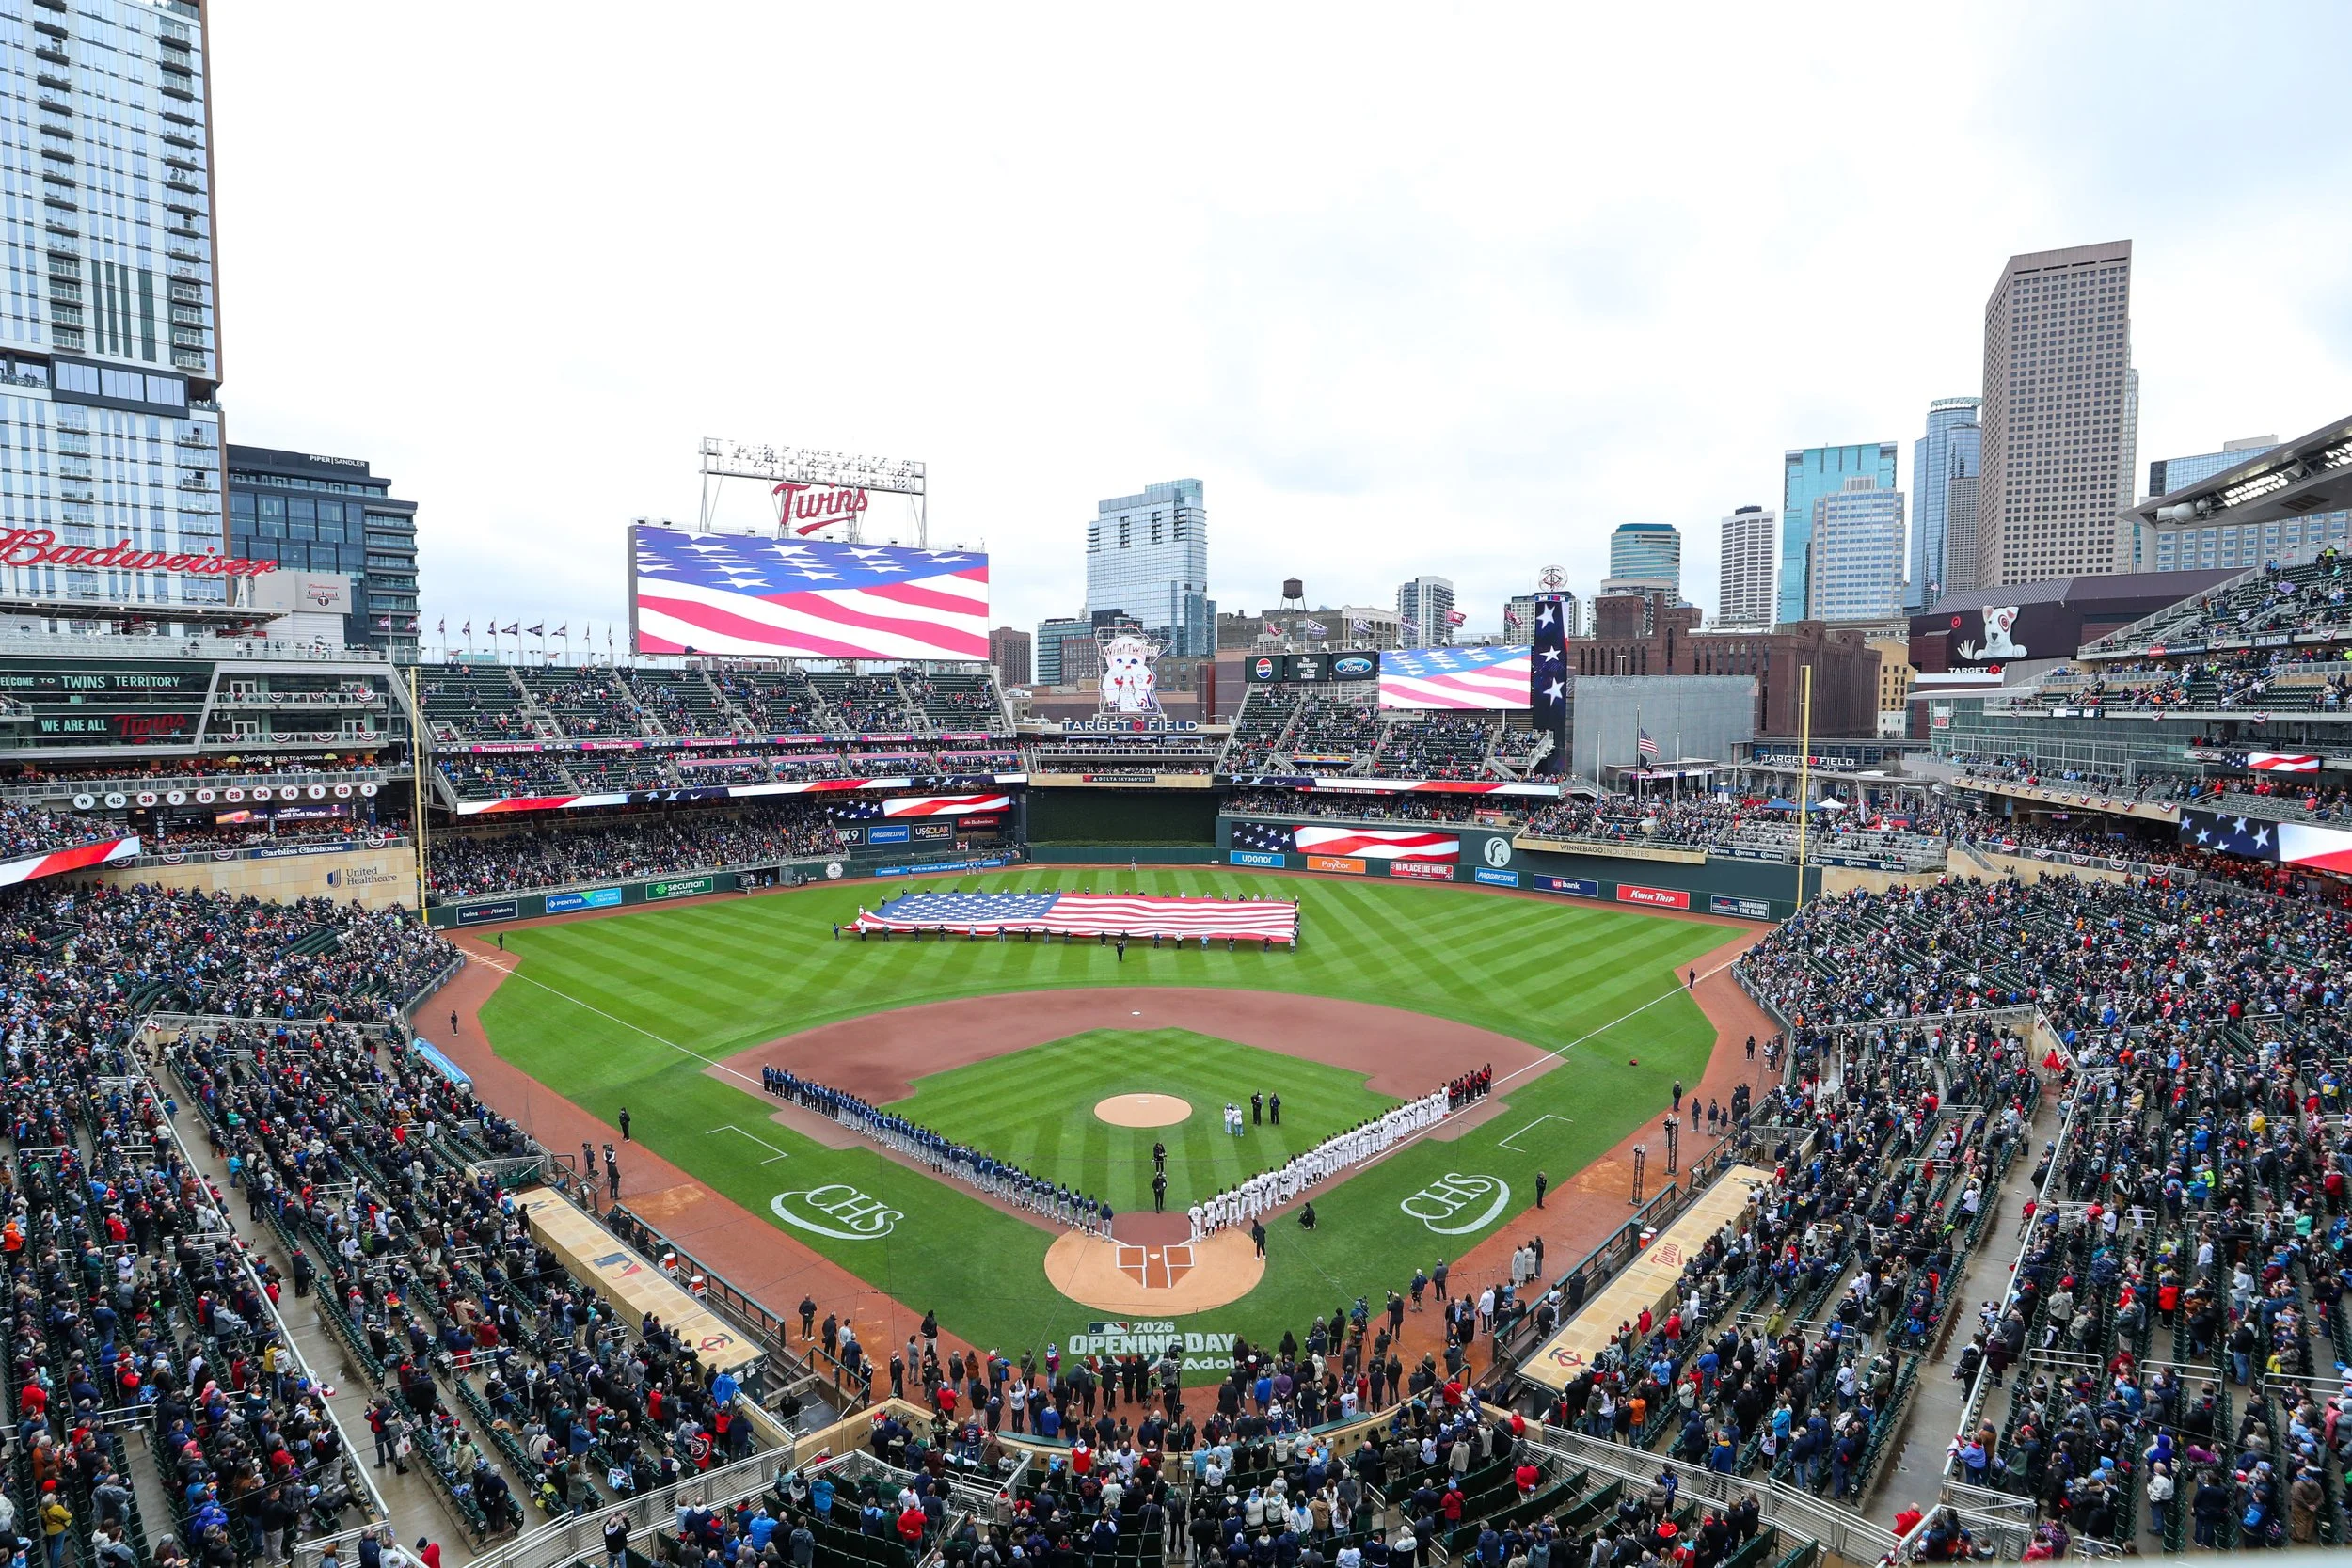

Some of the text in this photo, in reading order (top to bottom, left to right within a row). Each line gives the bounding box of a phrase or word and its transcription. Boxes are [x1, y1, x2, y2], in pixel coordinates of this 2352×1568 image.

[334, 457, 365, 467] SANDLER
[773, 483, 868, 531] Twins
[0, 528, 278, 576] Budweiser
[2255, 635, 2288, 647] END RACISM
[1342, 661, 1365, 672] Ford
[0, 677, 34, 687] ELCOME
[61, 675, 105, 689] TWINS
[114, 675, 180, 688] TERRITORY
[41, 721, 59, 732] WE
[64, 720, 84, 732] ARE
[87, 719, 107, 732] ALL
[1062, 721, 1198, 732] TARGET FIELD
[242, 754, 273, 763] Surfside
[1762, 754, 1855, 767] TARGET FIELD
[201, 792, 211, 800] 10
[338, 786, 348, 795] 29
[109, 797, 122, 805] 42
[141, 795, 153, 803] 36
[850, 830, 859, 841] 9
[871, 830, 907, 839] PROGRESSIVE
[261, 845, 344, 857] Carbliss Clubhouse
[1560, 844, 1650, 858] WINNEBAGO INDUSTRIES
[1708, 847, 1783, 861] Corona Corona Corona
[1242, 854, 1273, 864] uponor
[1809, 855, 1905, 871] Corona Corona Corona
[1321, 861, 1351, 870] Paycor
[1402, 863, 1422, 873] PLACE
[1431, 865, 1448, 875] HERE
[345, 866, 377, 878] United
[1477, 871, 1517, 882] PROGRESSIVE
[347, 873, 397, 886] Healthcare
[1562, 880, 1581, 890] bank
[667, 880, 705, 892] securian
[1738, 900, 1768, 911] CHANGING
[462, 907, 514, 918] twins.com/tickets
[1750, 908, 1767, 917] GAME
[1400, 1172, 1494, 1221] CHS
[804, 1184, 905, 1233] CHS
[1650, 1243, 1680, 1267] Twins
[1133, 1321, 1175, 1334] 2026
[1069, 1332, 1236, 1355] OPENING DAY
[1346, 1400, 1356, 1409] 34
